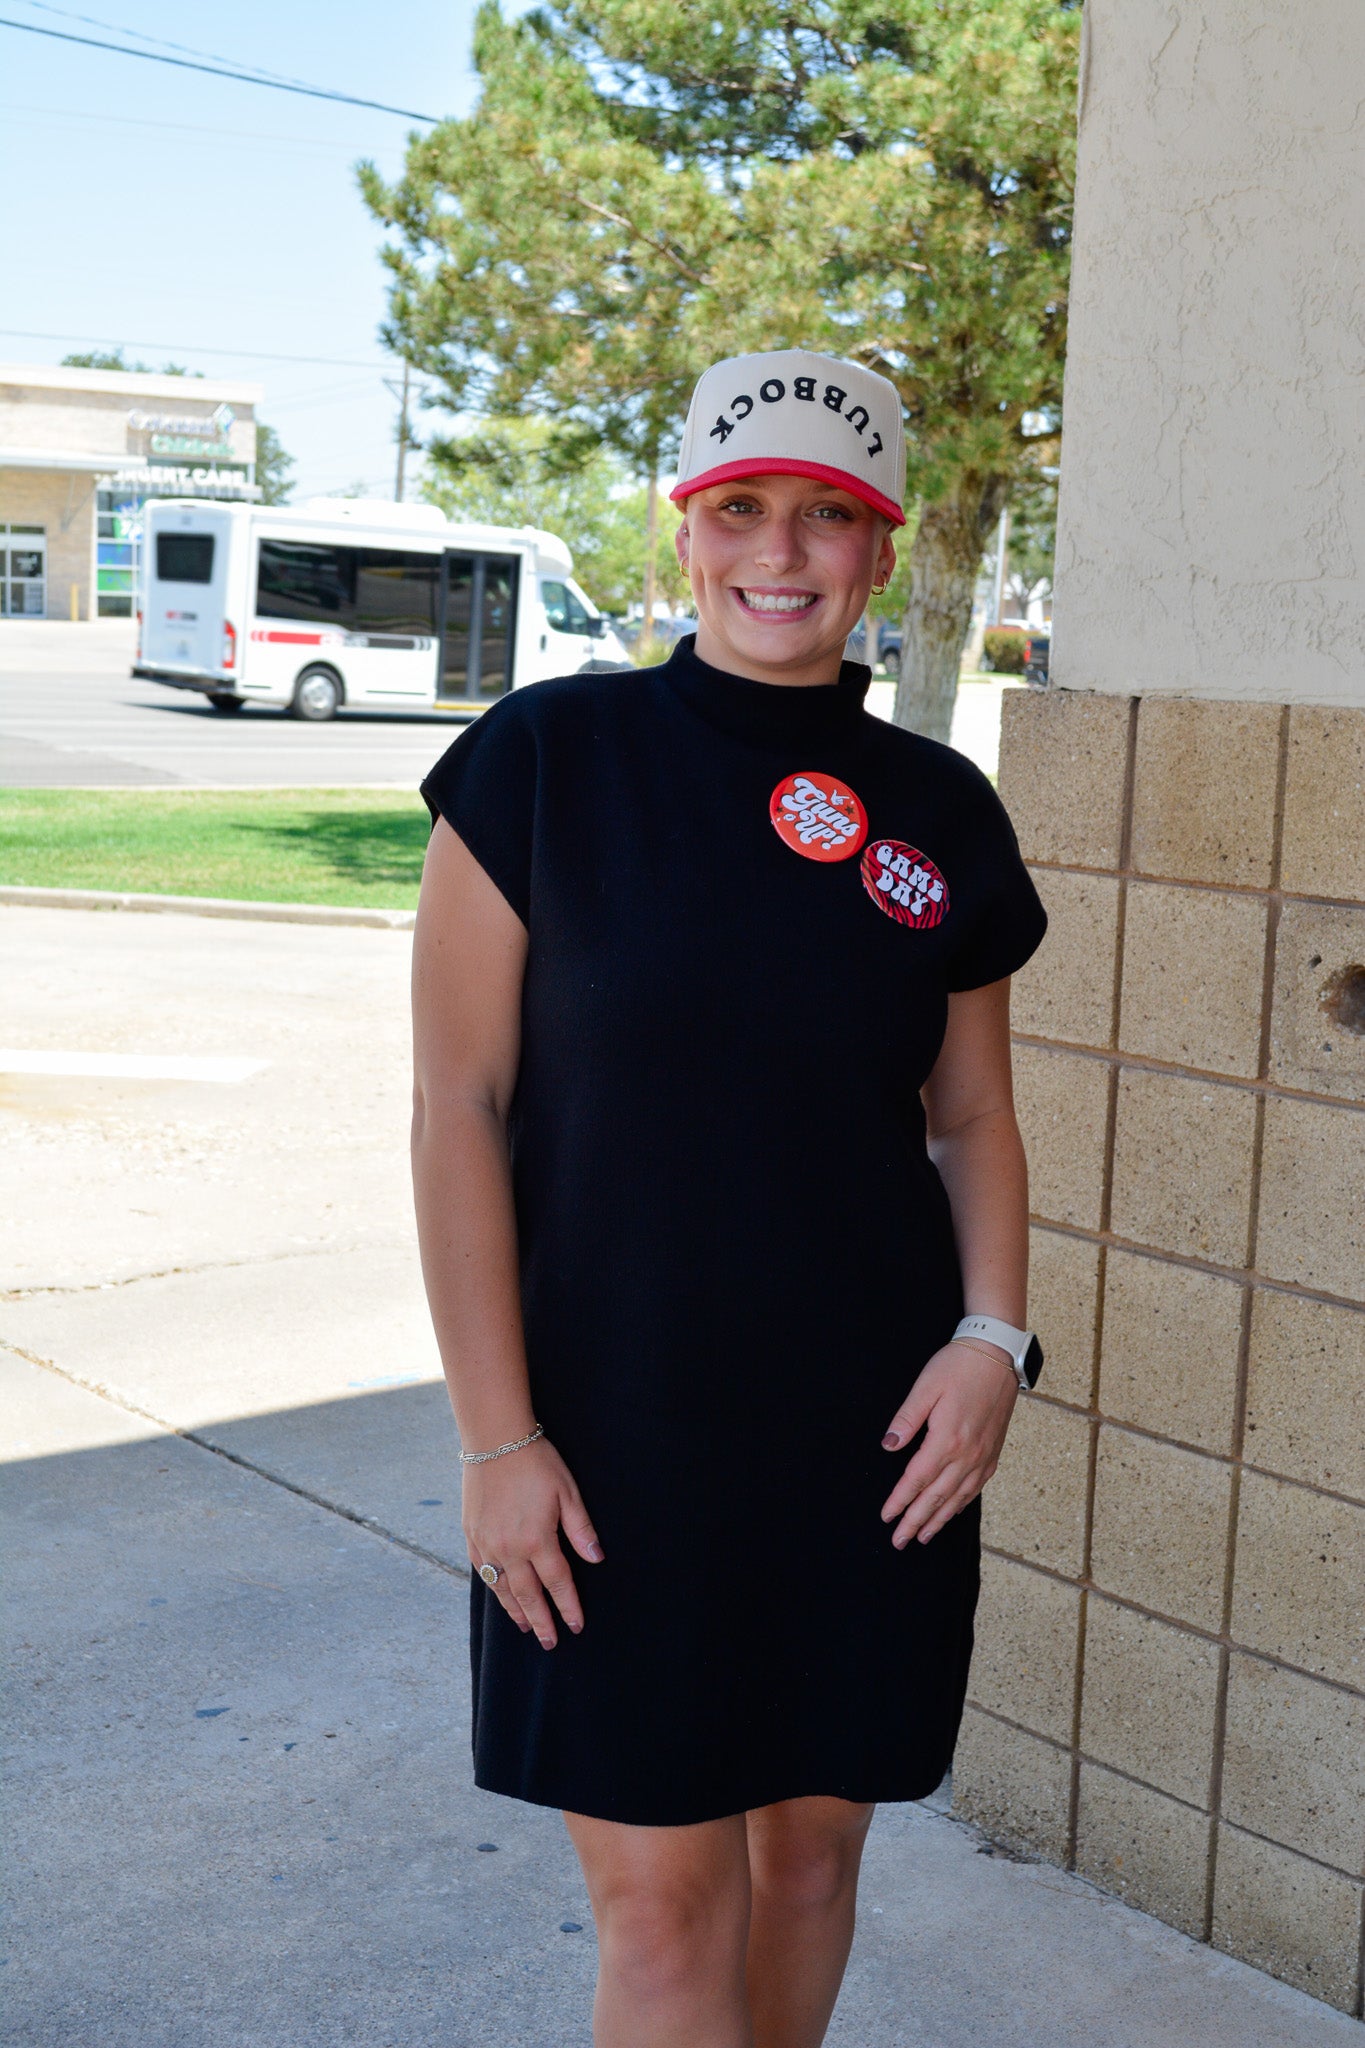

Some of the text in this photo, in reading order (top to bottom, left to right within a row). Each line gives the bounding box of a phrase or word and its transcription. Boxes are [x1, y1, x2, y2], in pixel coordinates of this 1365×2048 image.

[710, 376, 883, 458] LUBBOCK
[781, 777, 860, 836] Guns
[876, 845, 944, 902] GAME
[876, 868, 928, 916] DAY
